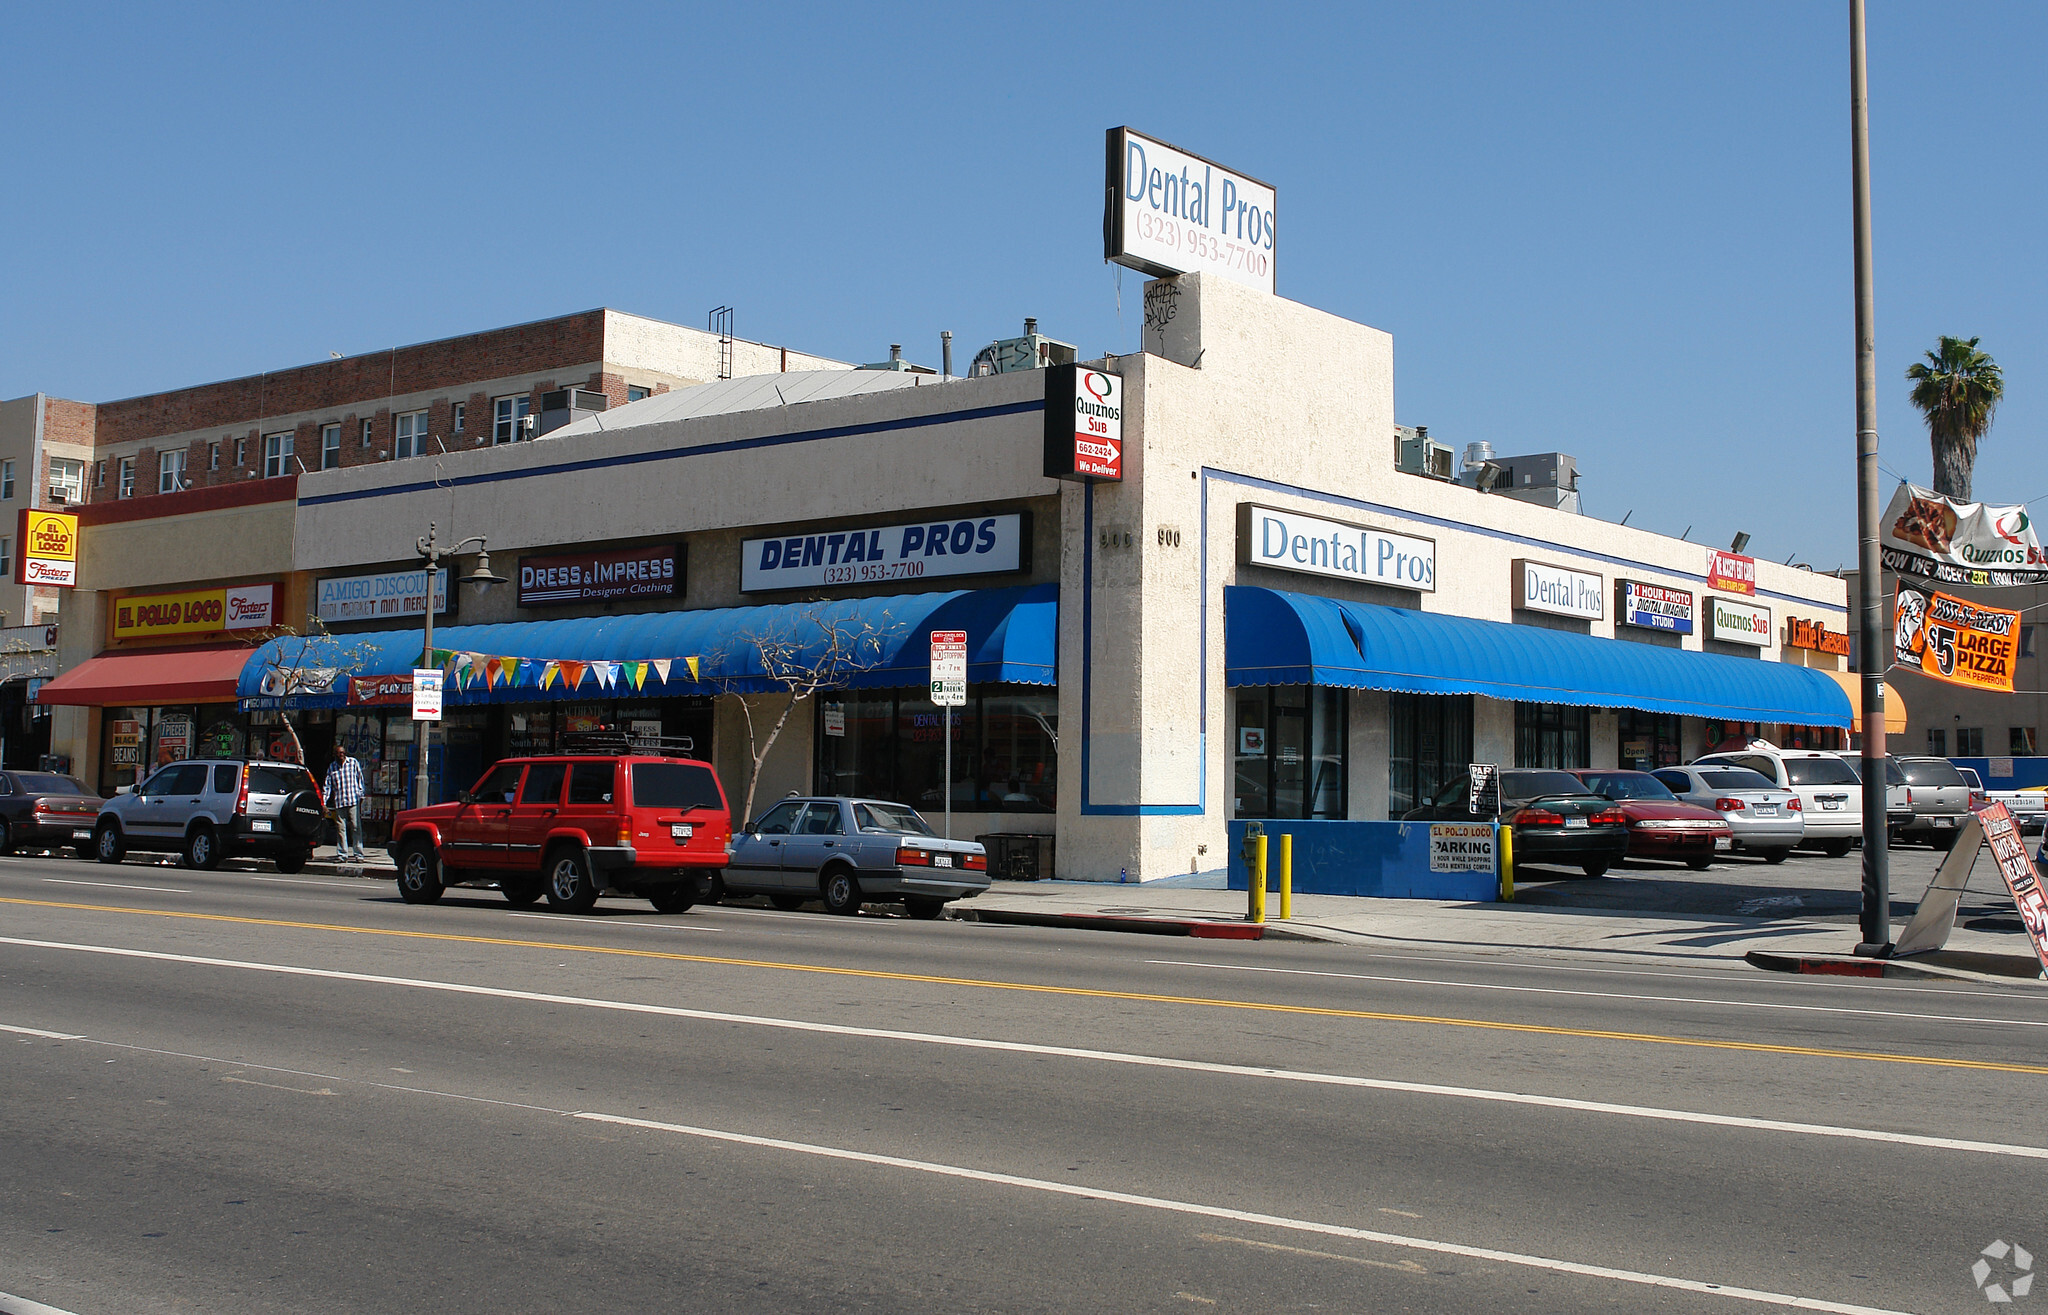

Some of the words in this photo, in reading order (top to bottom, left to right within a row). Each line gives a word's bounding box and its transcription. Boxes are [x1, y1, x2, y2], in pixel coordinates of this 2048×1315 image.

[1126, 140, 1211, 228] Dental
[1221, 178, 1273, 250] Pros
[1136, 208, 1181, 252] (323)
[1188, 228, 1267, 278] 953-7700
[1076, 397, 1120, 420] Quiznos
[1079, 443, 1112, 457] 662-2424
[1079, 460, 1090, 471] We
[1091, 463, 1117, 476] Deliver
[36, 532, 68, 543] POLLO
[47, 524, 58, 533] EL
[1158, 528, 1180, 547] 900
[39, 541, 65, 552] LOCO
[759, 530, 884, 571] DENTAL
[900, 518, 997, 559] PROS
[1100, 528, 1132, 548] 900
[1263, 516, 1366, 575] Dental
[1378, 537, 1432, 584] Pros
[1962, 543, 2024, 564] Quiznos
[28, 562, 72, 579] Fosters
[521, 565, 581, 589] DRESS
[583, 571, 592, 584] &
[594, 557, 674, 584] IMPRESS
[823, 564, 858, 584] (323)
[862, 561, 924, 582] 953-7700
[1911, 556, 1935, 575] WE
[1933, 564, 1971, 583] ACCEPT
[1971, 570, 1990, 585] EBT
[322, 580, 370, 602] AMIGO
[375, 572, 445, 597] DISCOUT
[582, 586, 627, 598] Designer
[630, 582, 673, 594] Clothing
[1528, 569, 1573, 608] Dental
[1578, 579, 1601, 611] Pros
[1627, 584, 1632, 595] D
[1636, 584, 1640, 594] 1
[1642, 586, 1664, 600] HOUR
[1665, 590, 1690, 605] PHOTO
[229, 597, 270, 621] Fosters
[341, 600, 376, 617] MARKET
[380, 598, 399, 614] MINI
[403, 594, 445, 612] MERCDO
[1628, 599, 1633, 607] &
[1637, 598, 1661, 613] DIGITAL
[1662, 603, 1689, 618] IMAGING
[118, 607, 134, 628] EL
[137, 602, 181, 627] POLLO
[183, 599, 222, 624] LOCO
[1630, 610, 1635, 621] J
[1652, 615, 1675, 628] STUDIO
[1716, 606, 1752, 633] Quiznos
[1789, 616, 1816, 650] Little
[1816, 621, 1850, 656] Caesars
[932, 650, 943, 660] NO
[1927, 624, 1956, 677] $5
[1957, 631, 2012, 658] LARGE
[1957, 650, 2007, 677] PIZZA
[934, 682, 940, 691] 2
[1956, 669, 1971, 678] WITH
[1972, 672, 2007, 686] PEPPERONI
[379, 683, 400, 694] PLAY
[577, 722, 600, 732] Sale
[914, 714, 939, 726] DENTAL
[942, 713, 961, 726] POS
[161, 722, 166, 736] 7
[166, 724, 185, 736] PIECES
[115, 735, 136, 744] BLACK
[114, 748, 136, 762] BEANS
[1625, 747, 1645, 756] Open
[296, 807, 320, 815] HONDA
[1434, 827, 1442, 836] EL
[1471, 828, 1491, 837] LOCO
[2002, 854, 2031, 882] READY
